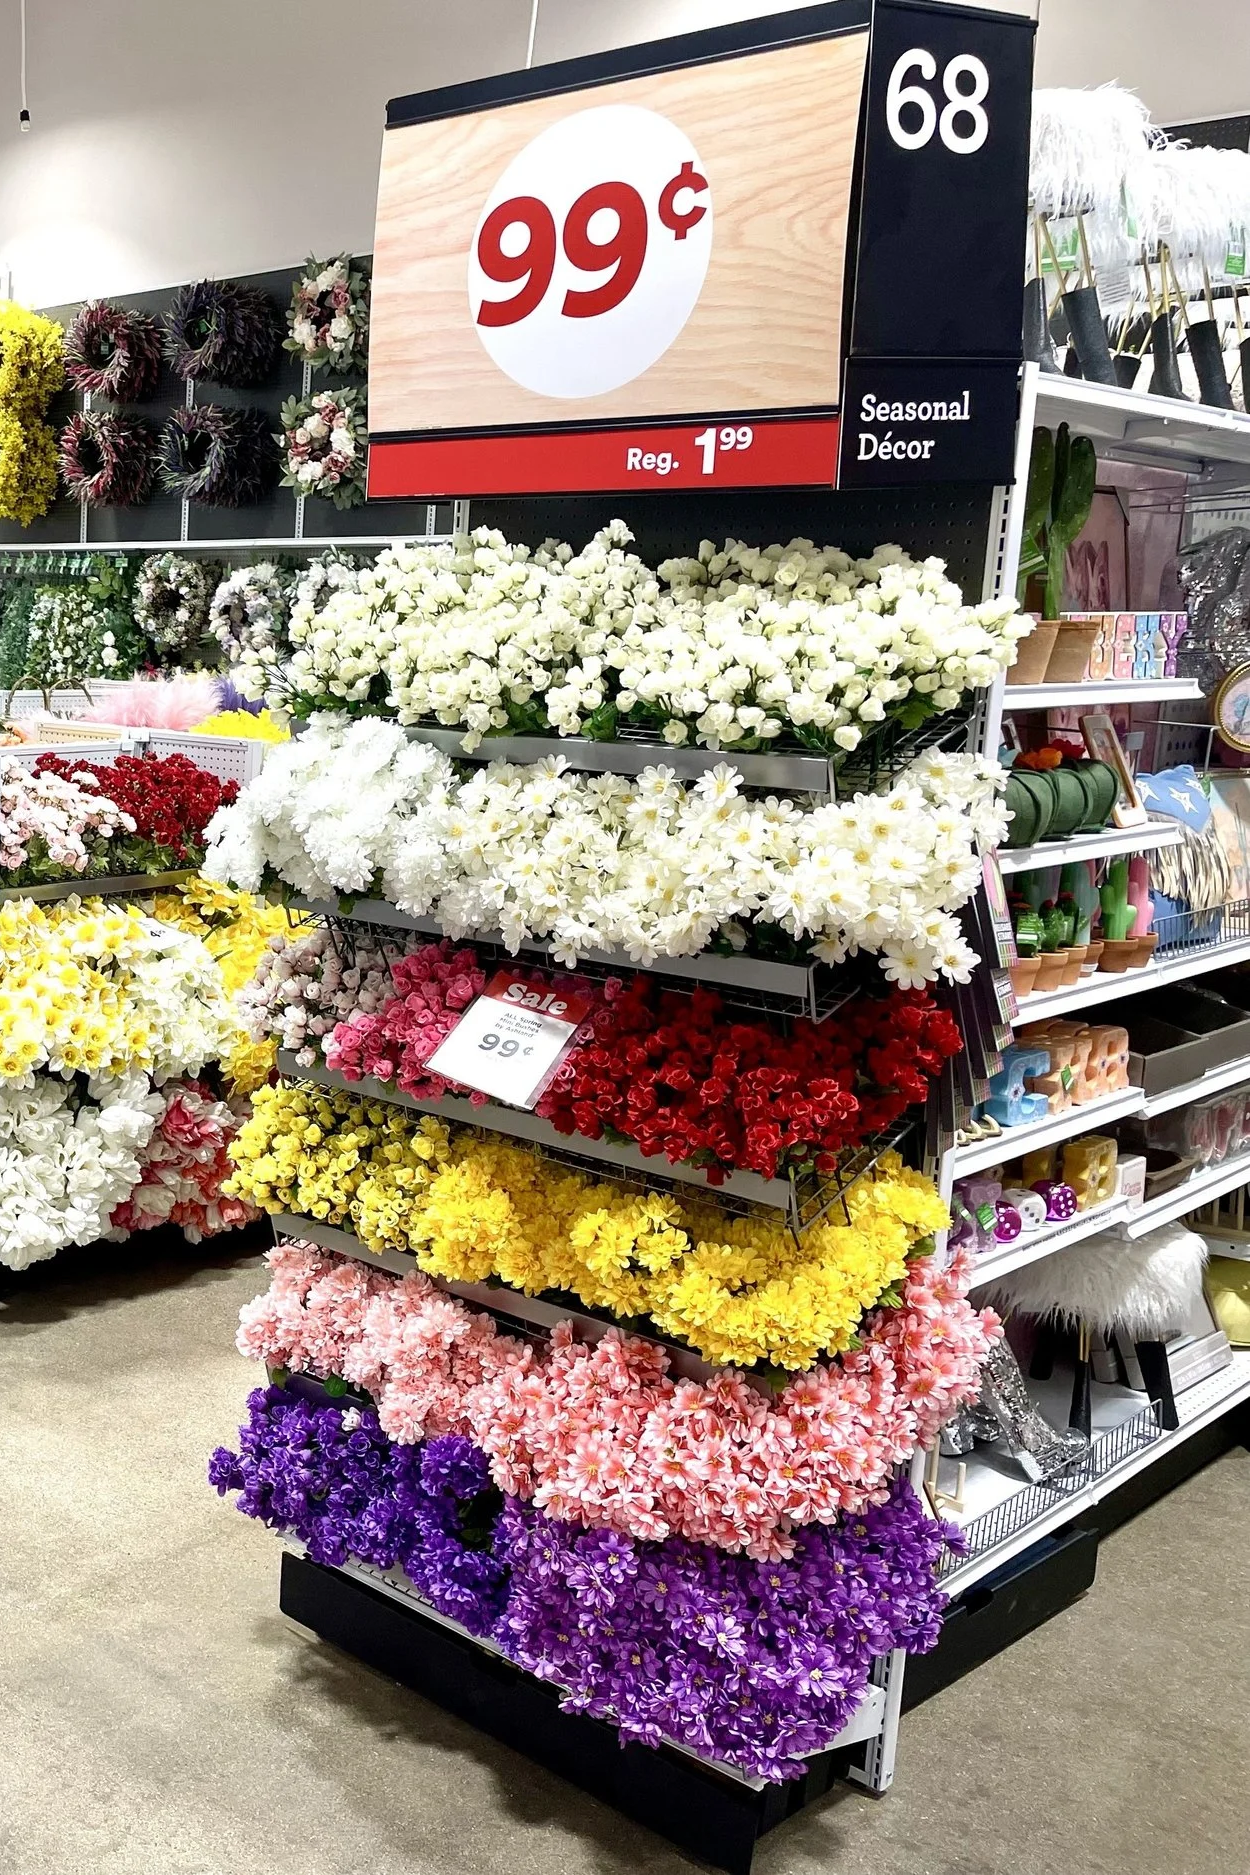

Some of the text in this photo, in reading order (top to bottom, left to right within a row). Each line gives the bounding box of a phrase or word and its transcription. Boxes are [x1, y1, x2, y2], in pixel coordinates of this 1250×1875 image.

[885, 48, 990, 154] 68
[476, 161, 709, 328] 99¢
[859, 391, 970, 423] Seasonal
[626, 447, 680, 473] Reg.
[857, 433, 936, 462] Décor
[502, 983, 568, 1015] Sale
[504, 1012, 543, 1029] ALL Spring
[514, 1021, 540, 1034] Bushes
[478, 1033, 534, 1058] 99¢
